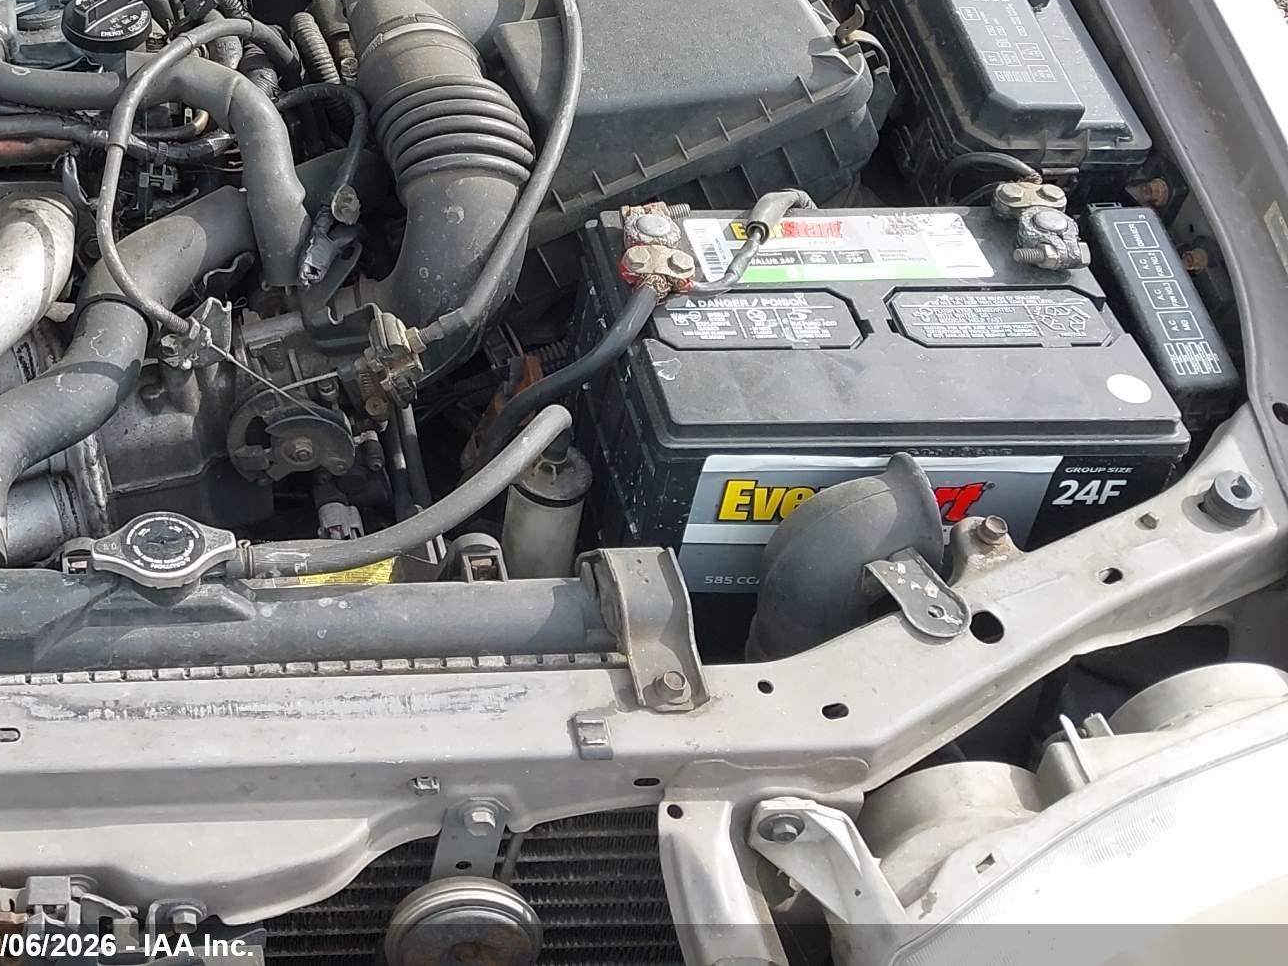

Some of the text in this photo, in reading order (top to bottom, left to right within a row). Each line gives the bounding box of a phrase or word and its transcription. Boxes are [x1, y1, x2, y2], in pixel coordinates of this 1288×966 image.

[1128, 223, 1145, 247] DIMMER
[698, 298, 750, 308] DANGER
[762, 297, 808, 307] POISON
[1064, 466, 1134, 475] GROUP SIZE
[1051, 478, 1128, 506] 24F
[704, 576, 734, 585] 585
